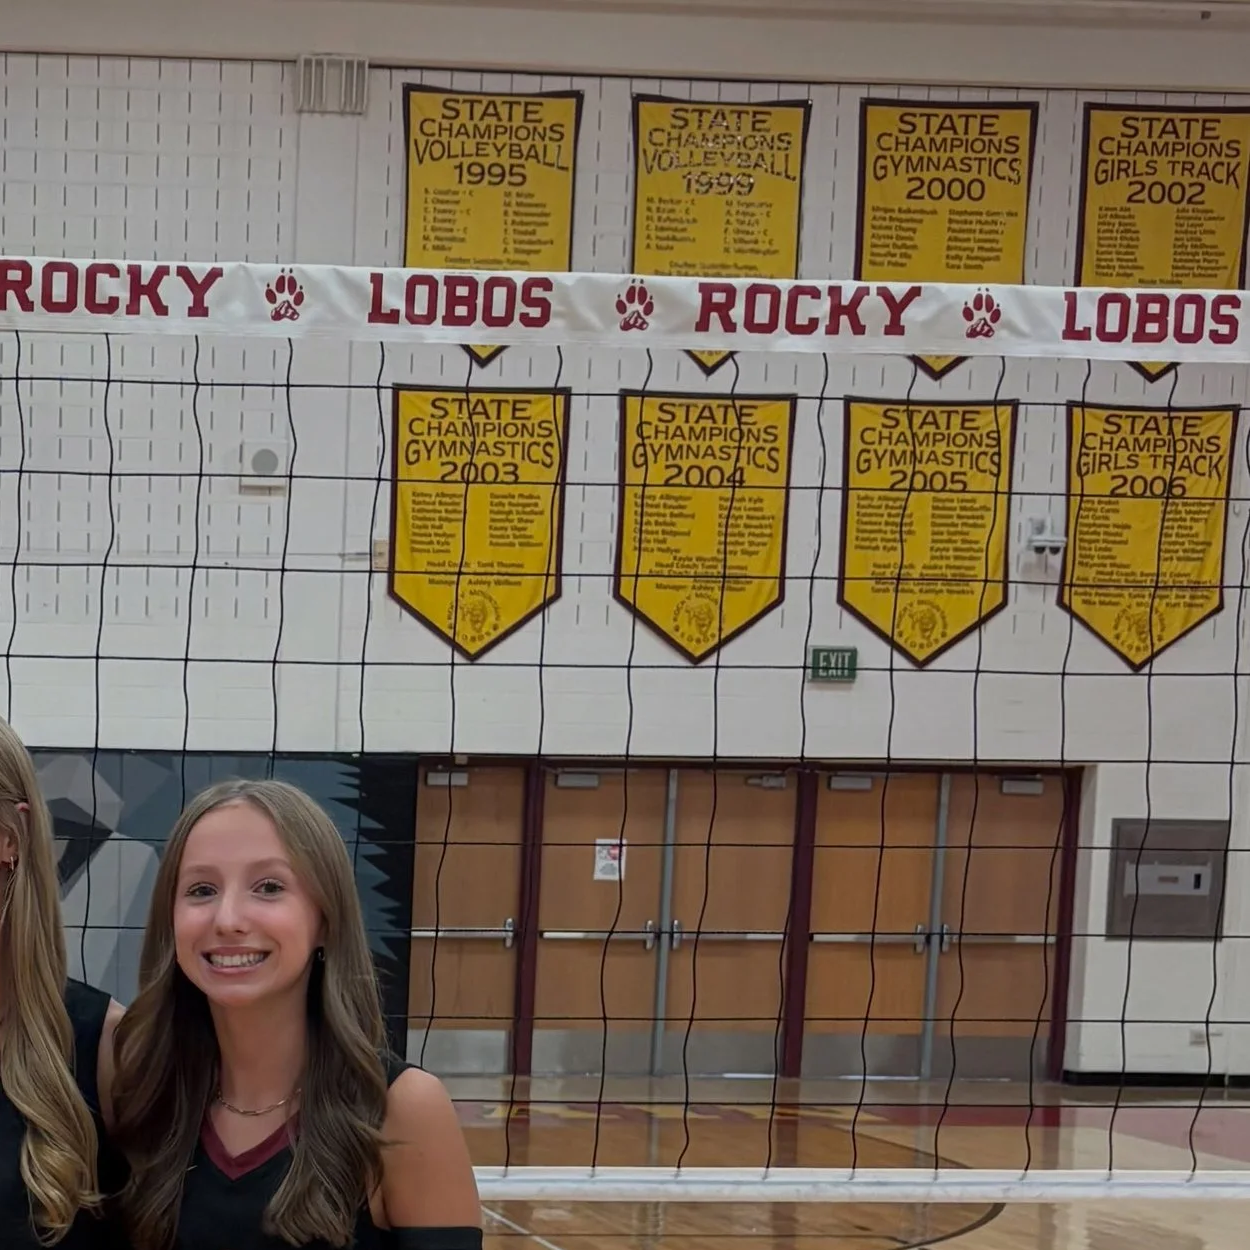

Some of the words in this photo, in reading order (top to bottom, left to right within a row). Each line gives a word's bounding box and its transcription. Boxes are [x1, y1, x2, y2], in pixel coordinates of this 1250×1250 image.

[441, 98, 544, 124] STATE
[670, 108, 772, 132] STATE
[419, 118, 565, 142] CHAMPIONS
[898, 112, 1000, 136] STATE
[1120, 117, 1221, 141] STATE
[647, 128, 793, 152] CHAMPIONS
[876, 132, 1021, 155] CHAMPIONS
[1098, 137, 1241, 159] CHAMPIONS
[414, 140, 570, 172] VOLLEYBALL
[642, 148, 798, 183] VOLLEYBALL
[453, 162, 527, 187] 1995
[873, 155, 1022, 186] GYMNASTICS
[1094, 159, 1158, 186] GIRLS
[1167, 161, 1241, 190] TRACK
[682, 171, 755, 196] 1999
[906, 178, 985, 202] 2000
[1127, 181, 1206, 205] 2002
[367, 272, 554, 328] LOBOS
[695, 282, 922, 336] ROCKY
[1062, 291, 1242, 345] LOBOS
[430, 399, 532, 421] STATE
[657, 403, 758, 425] STATE
[881, 408, 981, 431] STATE
[408, 418, 553, 438] CHAMPIONS
[637, 421, 779, 443] CHAMPIONS
[1103, 414, 1202, 436] STATE
[860, 427, 1000, 448] CHAMPIONS
[1082, 433, 1221, 454] CHAMPIONS
[405, 440, 555, 469] GYMNASTICS
[632, 445, 780, 474] GYMNASTICS
[856, 449, 1000, 477] GYMNASTICS
[1077, 453, 1140, 478] GIRLS
[1151, 454, 1223, 480] TRACK
[440, 462, 519, 484] 2003
[664, 464, 746, 488] 2004
[889, 471, 968, 492] 2005
[1110, 475, 1187, 498] 2006
[819, 651, 852, 677] EXIT
